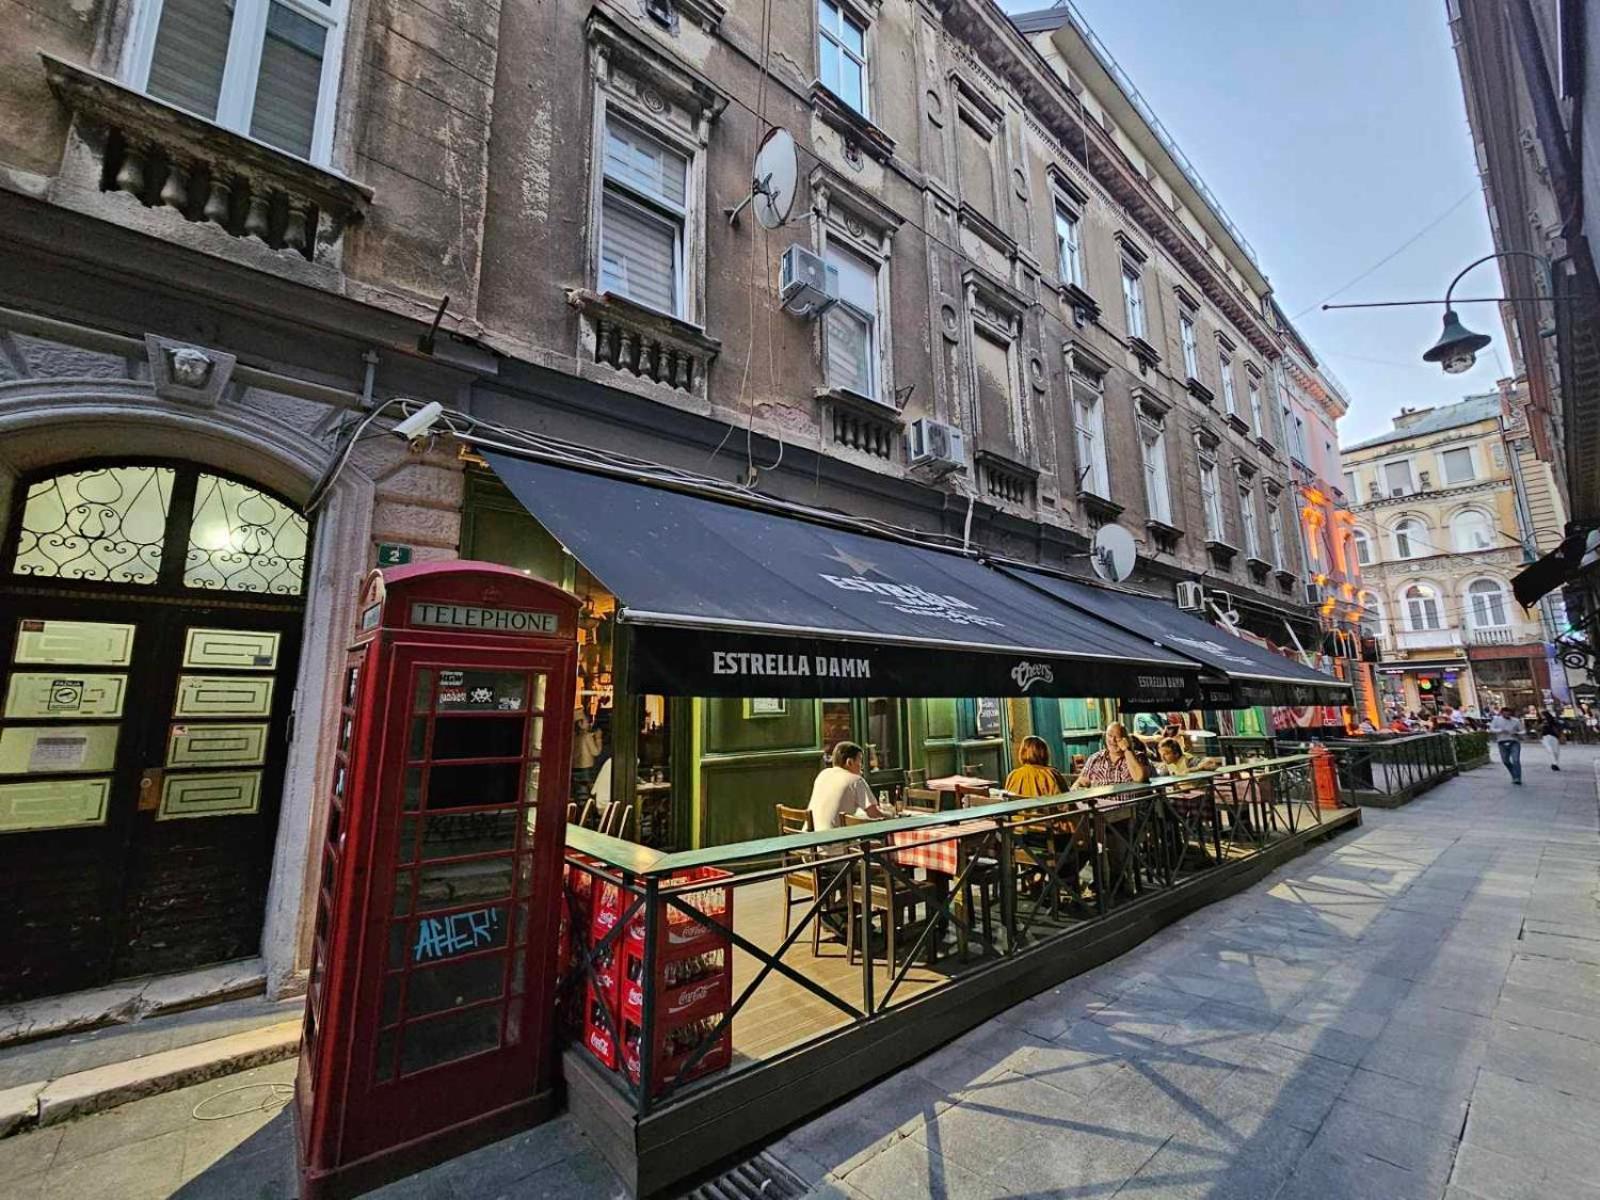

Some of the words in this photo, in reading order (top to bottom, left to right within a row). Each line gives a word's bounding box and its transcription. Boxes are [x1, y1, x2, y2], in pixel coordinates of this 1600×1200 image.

[389, 550, 400, 562] 2
[417, 605, 553, 632] TELEPHONE
[713, 651, 810, 676] ESTRELLA
[815, 656, 871, 678] DAMM
[1011, 661, 1054, 691] Cheers
